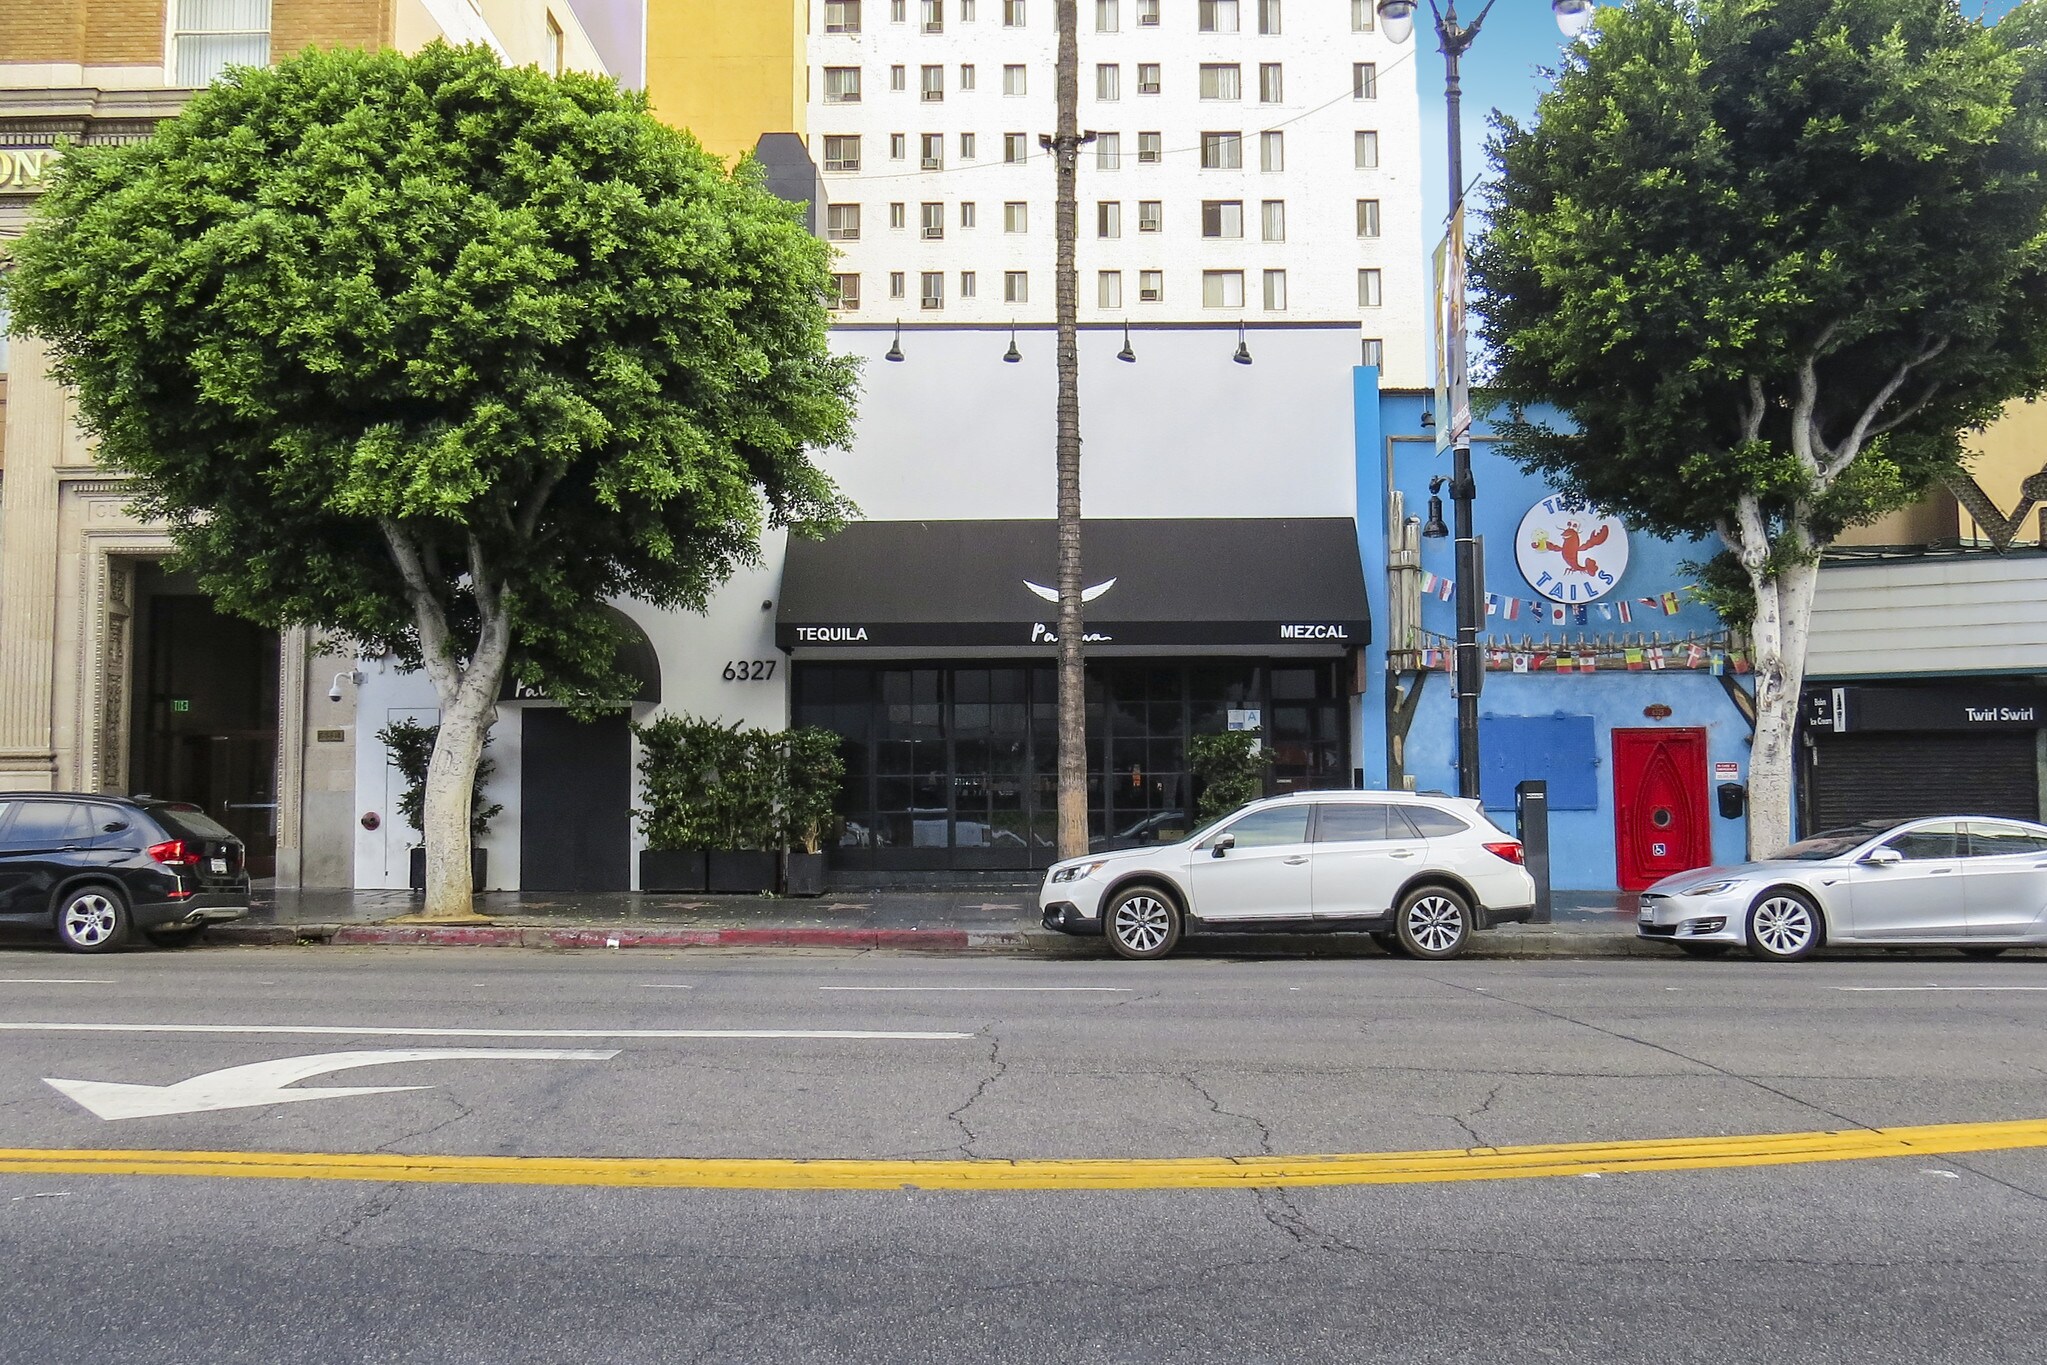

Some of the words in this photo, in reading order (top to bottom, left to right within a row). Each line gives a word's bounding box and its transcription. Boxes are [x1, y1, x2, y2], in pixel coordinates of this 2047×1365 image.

[1536, 570, 1614, 600] TAILS
[797, 627, 868, 641] TEQUILA
[1280, 625, 1348, 638] MEZCAL
[722, 660, 776, 681] 6327
[1247, 711, 1257, 722] A
[1965, 707, 1998, 721] Twirl
[2000, 707, 2034, 721] Swirl
